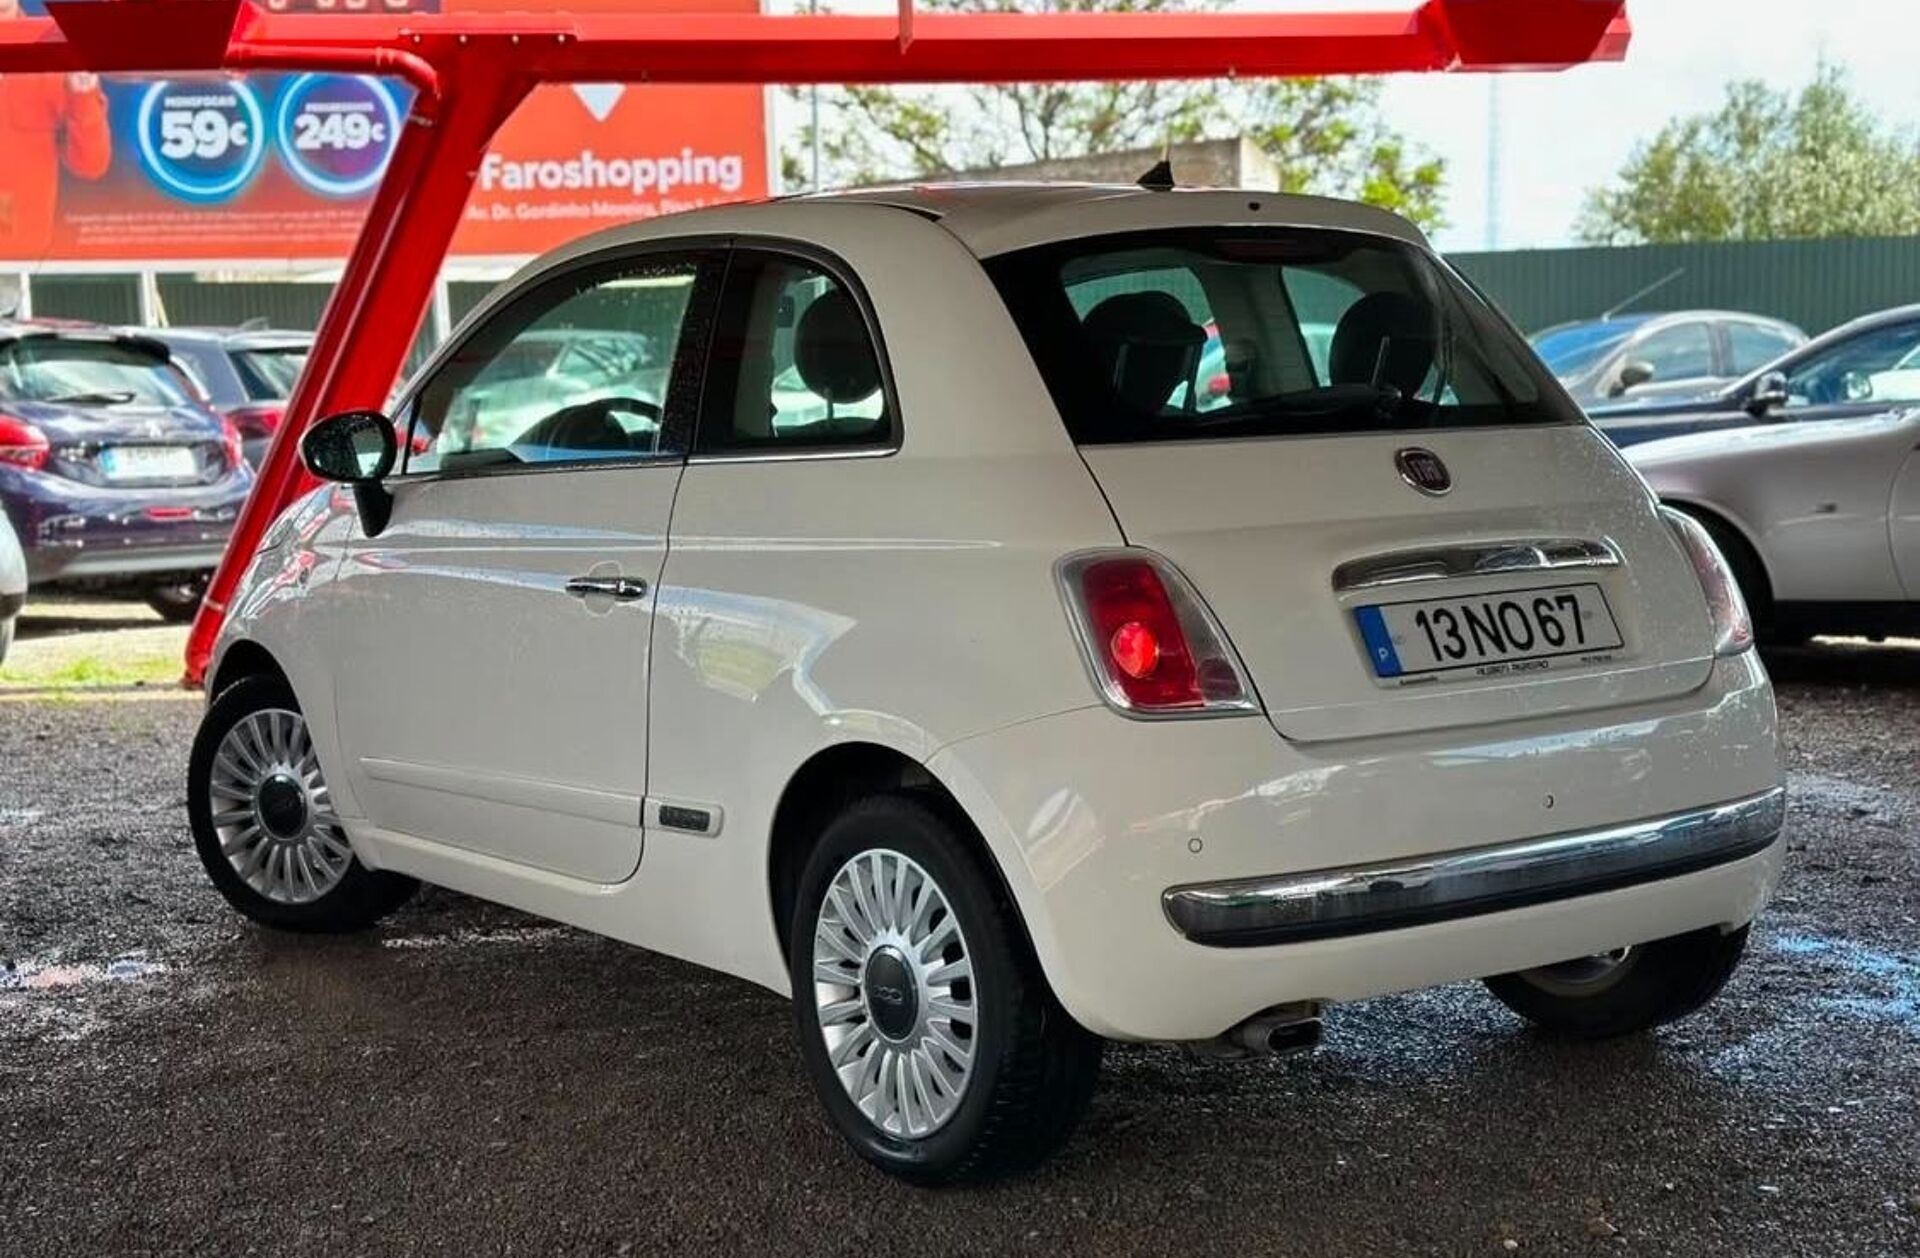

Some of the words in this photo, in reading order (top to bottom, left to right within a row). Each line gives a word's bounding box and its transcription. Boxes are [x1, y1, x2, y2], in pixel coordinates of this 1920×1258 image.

[161, 110, 248, 159] 59€
[295, 113, 385, 149] 249€
[480, 147, 743, 194] Faroshopping
[1378, 647, 1389, 662] P
